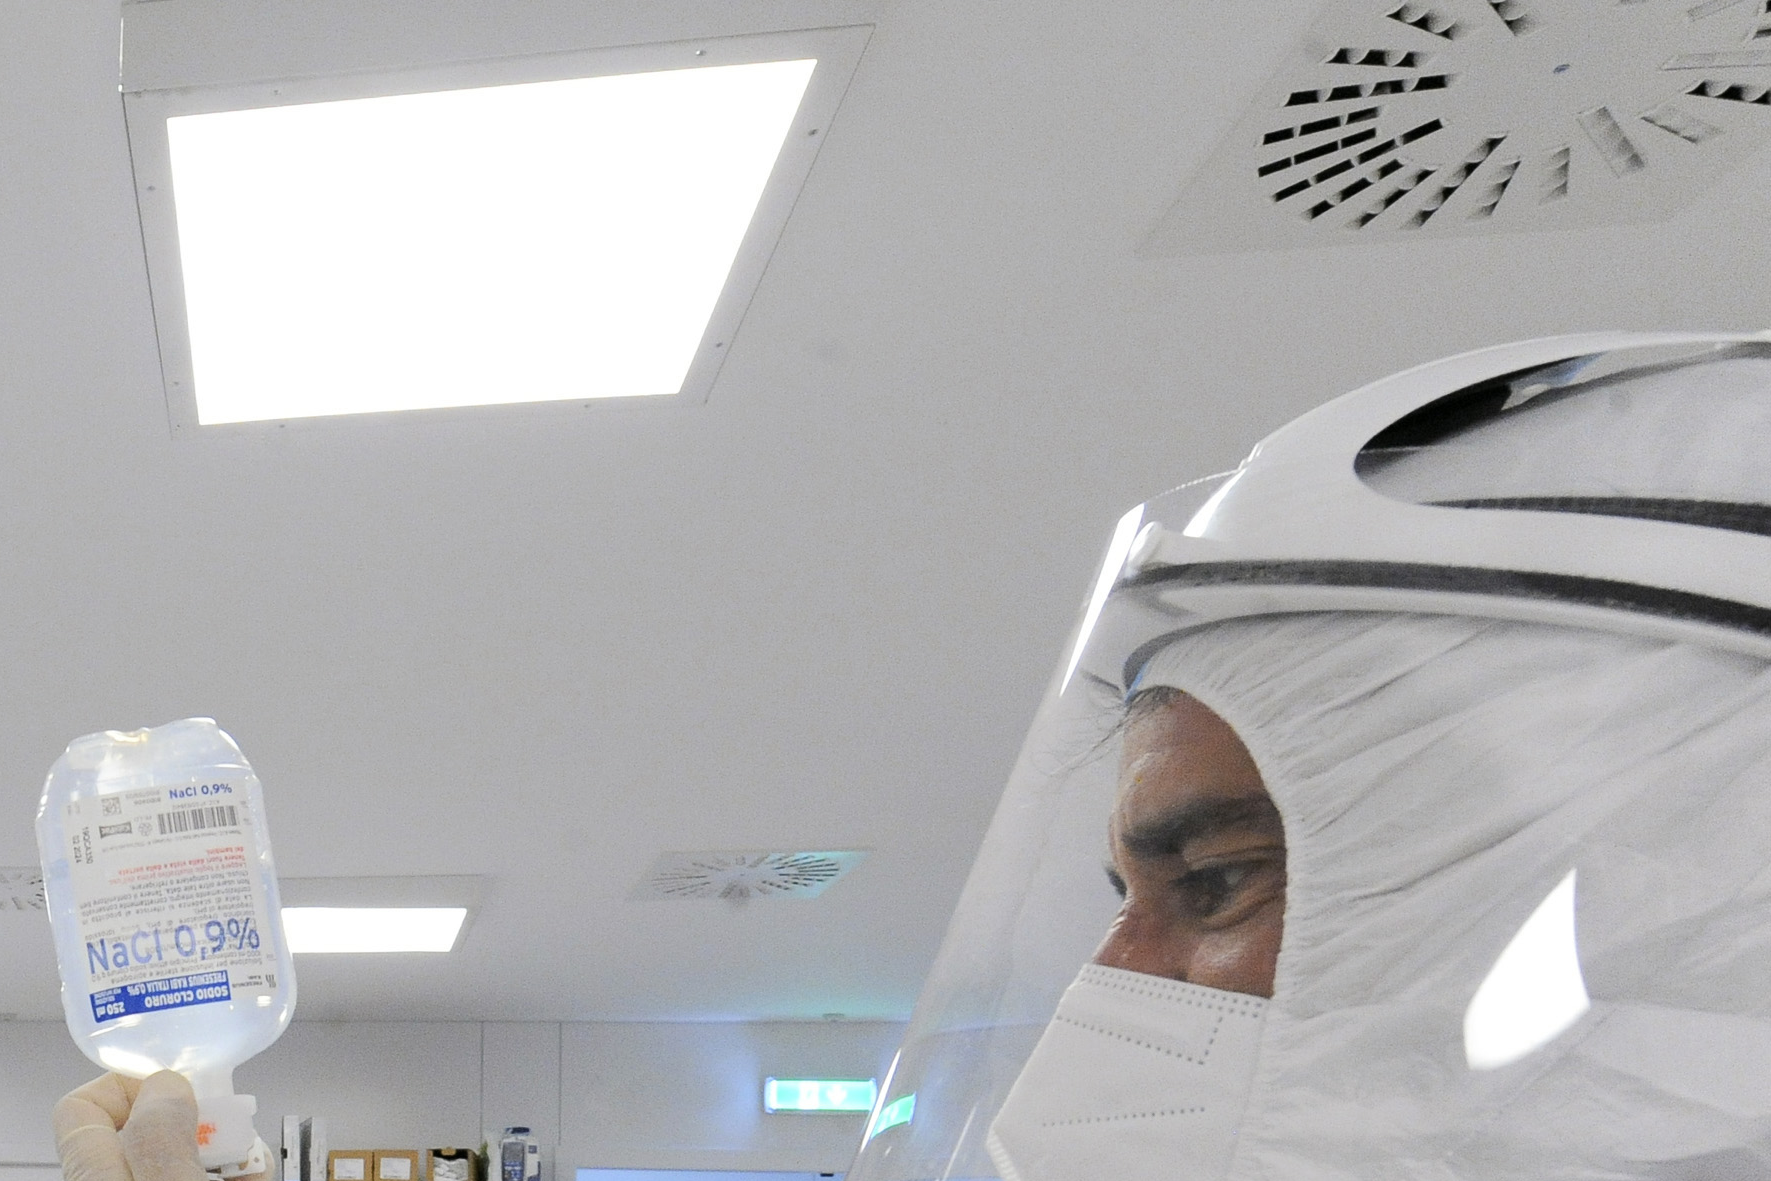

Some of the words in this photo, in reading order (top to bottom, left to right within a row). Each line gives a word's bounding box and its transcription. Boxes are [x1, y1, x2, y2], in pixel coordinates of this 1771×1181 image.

[169, 786, 196, 799] NaCl
[201, 782, 232, 796] 0,9%
[188, 858, 204, 866] dalla
[224, 853, 244, 861] Tenere
[145, 864, 161, 872] dalla
[220, 860, 246, 870] Leggere
[175, 873, 209, 884] congelare
[210, 872, 224, 880] Non
[236, 877, 249, 885] Non
[128, 879, 168, 891] refrigerare.
[182, 884, 196, 892] tale
[198, 882, 214, 890] oltre
[139, 889, 162, 898] Tenere
[195, 884, 250, 898] confezionamento
[243, 892, 251, 900] La
[92, 893, 132, 906] contenitore
[119, 896, 167, 909] correttamente
[178, 898, 211, 908] scadenza
[225, 894, 240, 902] data
[135, 905, 164, 915] riferisce
[90, 911, 122, 922] prodotto
[85, 926, 163, 973] NaCl
[173, 914, 261, 963] 0,9%
[229, 956, 261, 968] Soluzione
[156, 968, 177, 978] sterile
[181, 963, 213, 974] infusione
[110, 971, 147, 984] apirogena
[170, 977, 186, 989] KABI
[187, 971, 226, 986] FRESENIUS
[126, 982, 145, 996] 0,9%
[145, 979, 169, 992] ITALIA
[231, 979, 262, 988] FRESENIUS
[196, 984, 228, 1000] SODIO
[143, 989, 194, 1008] CLORURO
[95, 1005, 106, 1018] ml
[106, 1001, 125, 1015] 250
